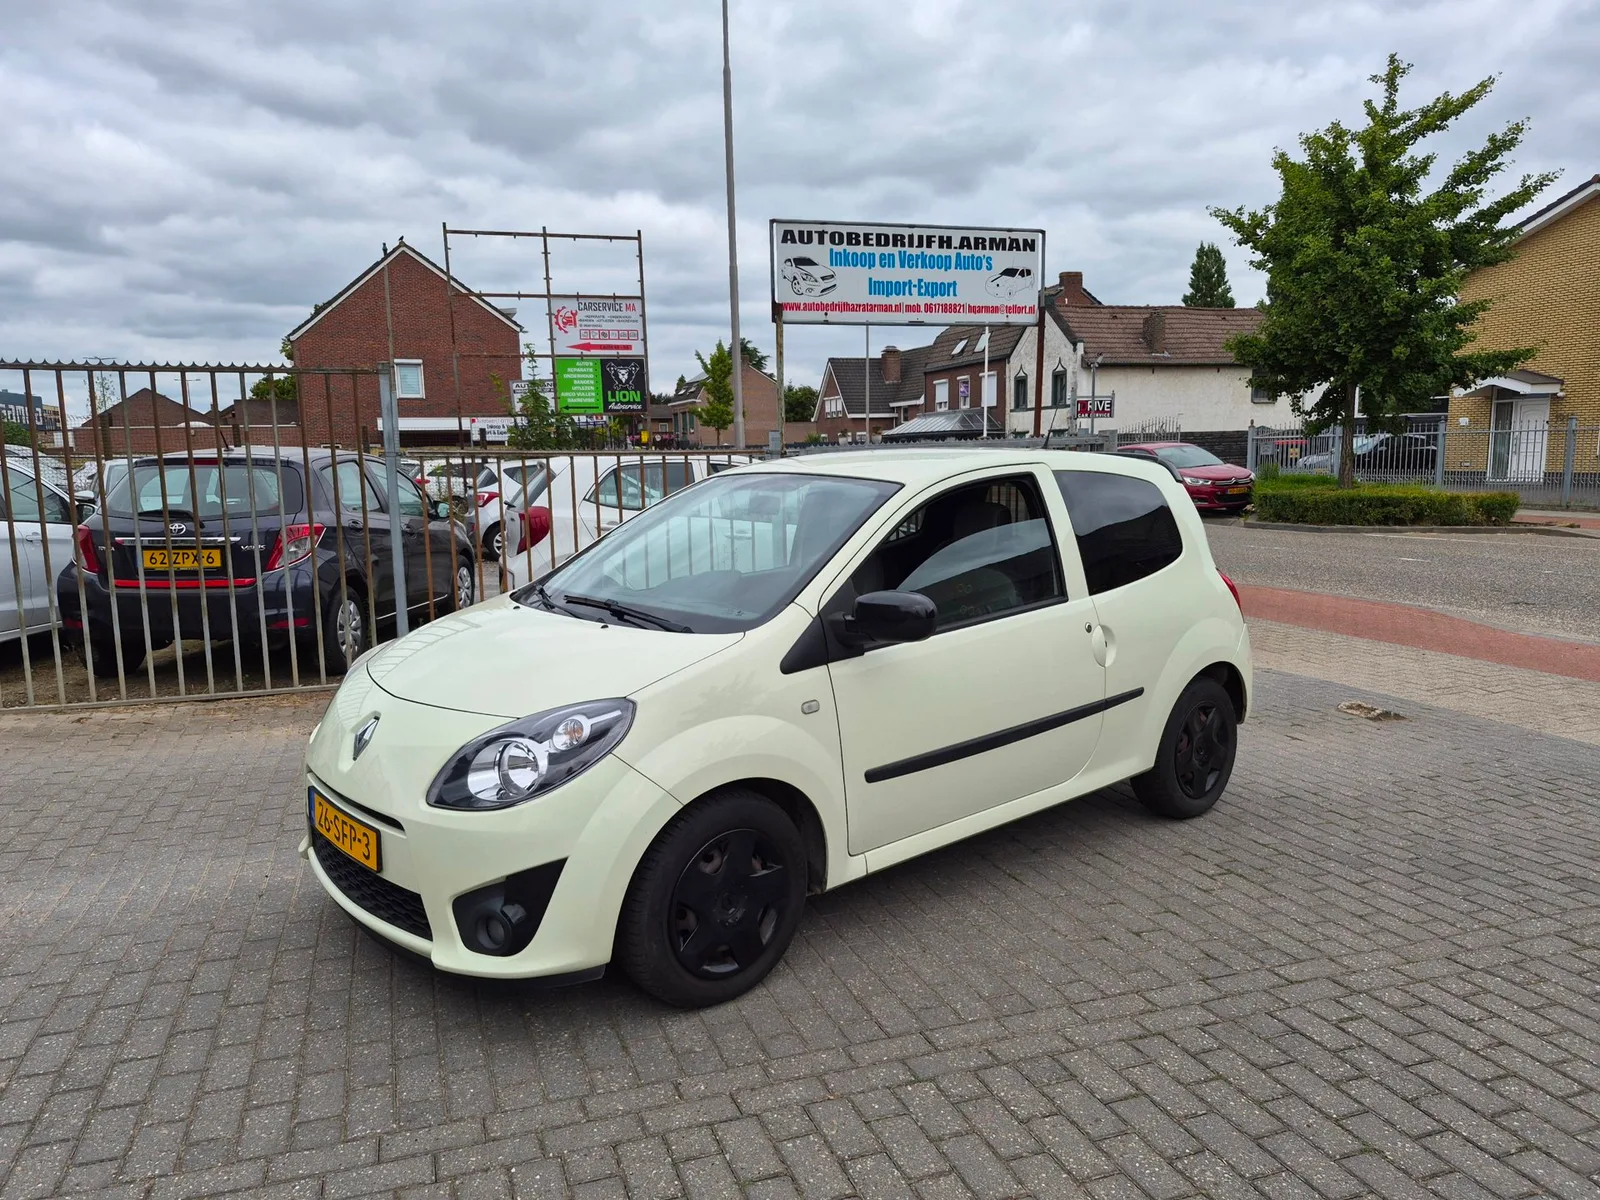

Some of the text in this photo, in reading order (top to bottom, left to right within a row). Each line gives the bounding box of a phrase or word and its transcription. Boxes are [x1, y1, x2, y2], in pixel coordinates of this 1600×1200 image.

[829, 248, 993, 271] Inkoop en Verkoop Auto's
[868, 278, 957, 298] Import-Export
[577, 302, 636, 312] CARSERVICE MA
[607, 391, 641, 402] LION
[608, 402, 642, 410] Autoservice
[149, 552, 215, 565] 62ZPX-6
[318, 801, 371, 860] 26-SFP-3
